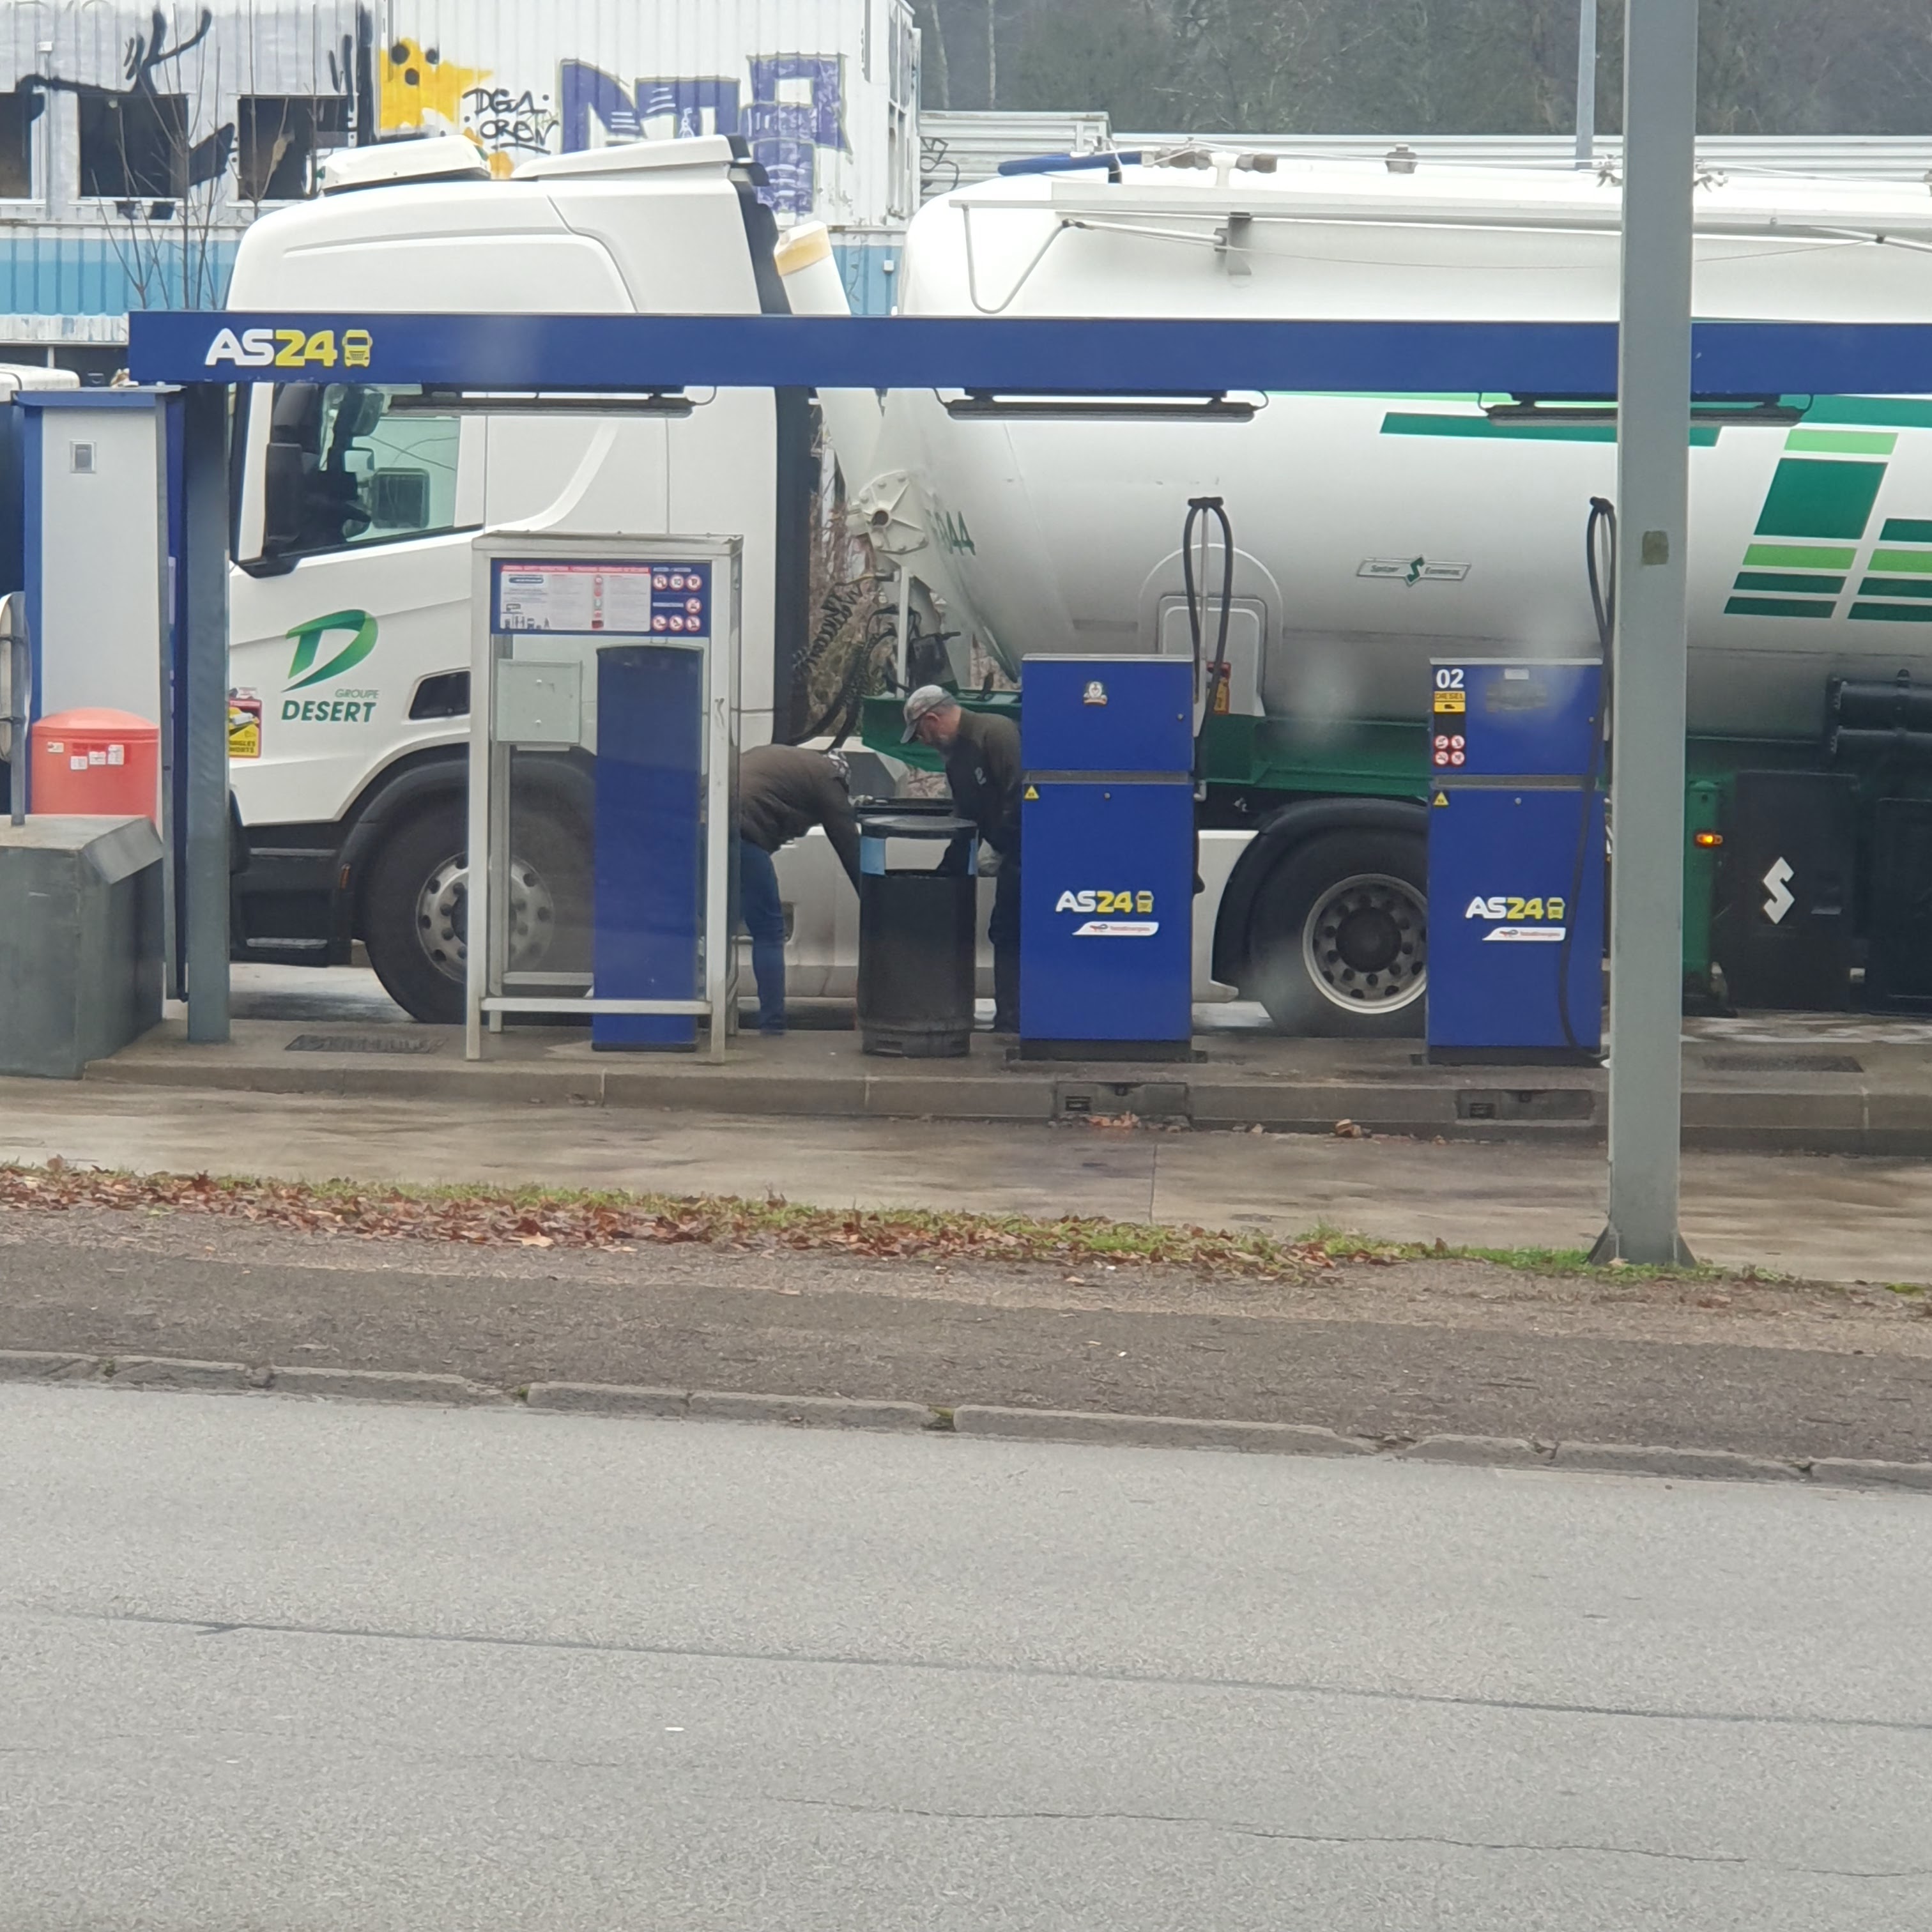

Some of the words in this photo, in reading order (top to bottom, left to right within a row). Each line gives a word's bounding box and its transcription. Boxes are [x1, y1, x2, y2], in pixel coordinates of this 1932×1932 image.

[204, 327, 338, 367] AS24
[1436, 668, 1464, 689] 02
[335, 688, 379, 699] GROUPE
[281, 700, 376, 723] DESERT
[1055, 890, 1133, 913] AS24
[1465, 896, 1544, 920] AS24
